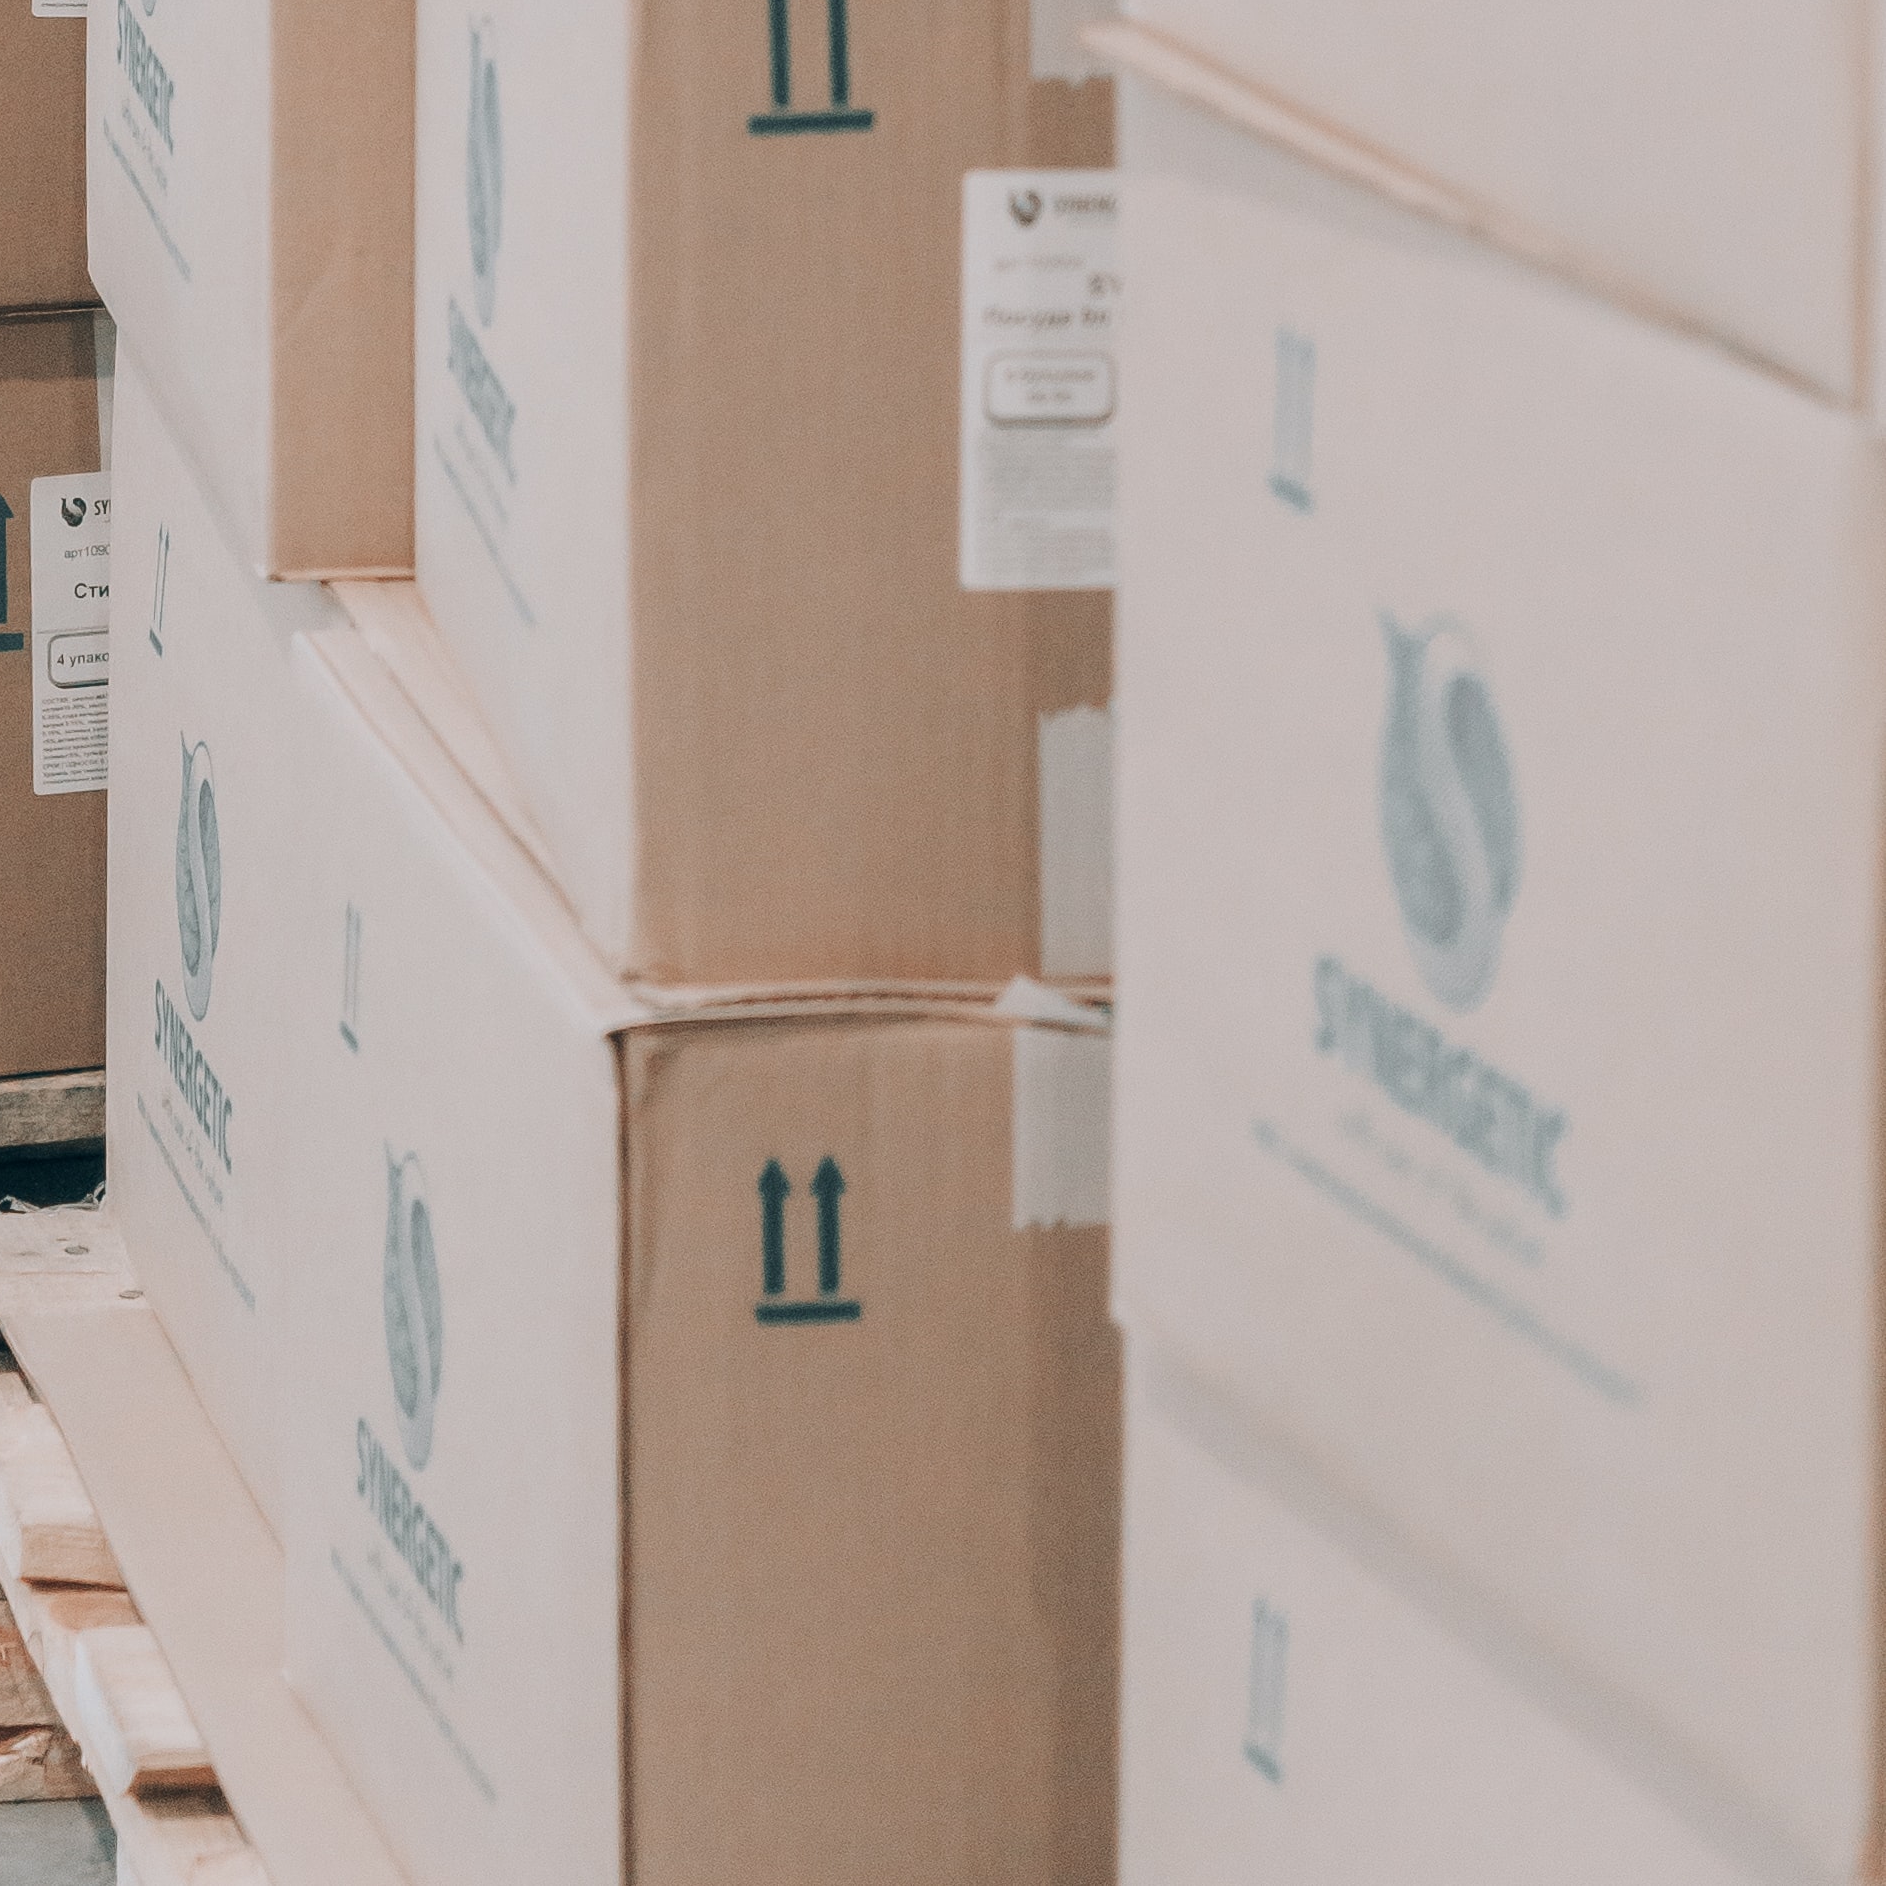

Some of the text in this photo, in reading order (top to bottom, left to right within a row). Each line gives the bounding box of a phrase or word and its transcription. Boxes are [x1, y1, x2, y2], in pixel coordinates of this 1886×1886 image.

[74, 582, 110, 599] Сти
[57, 654, 65, 666] 4
[154, 978, 232, 1176] SYNERGETIC
